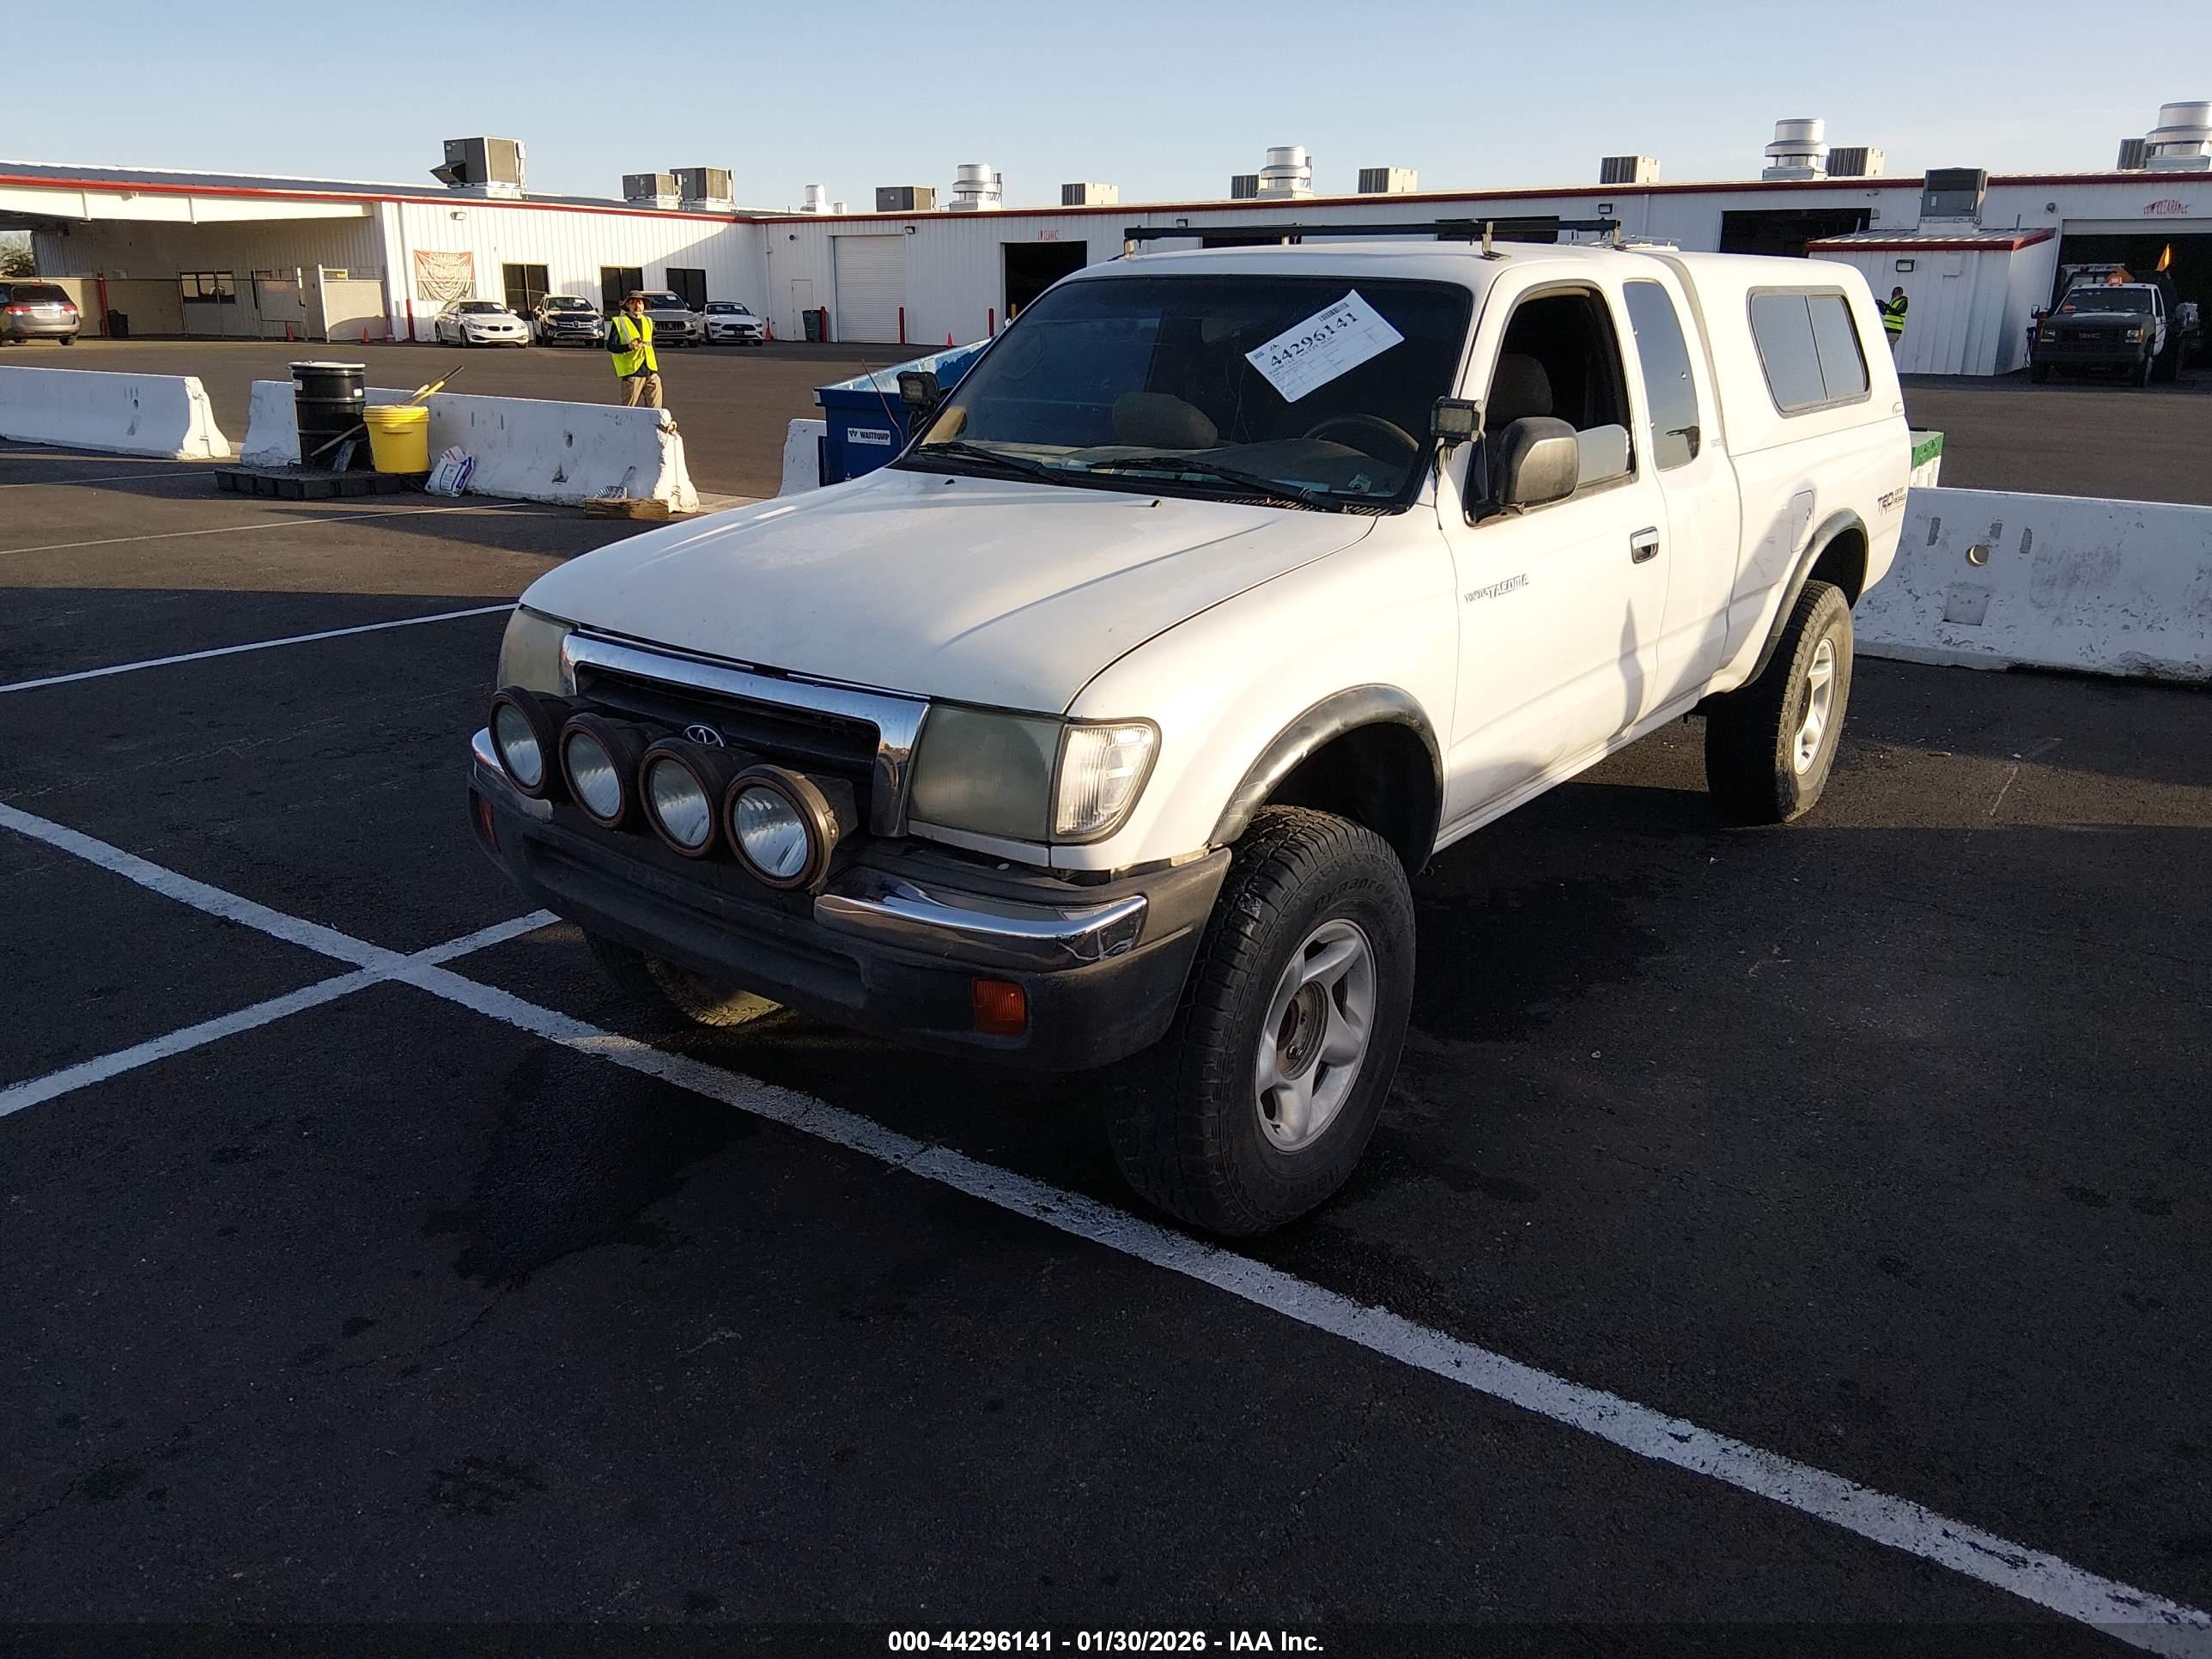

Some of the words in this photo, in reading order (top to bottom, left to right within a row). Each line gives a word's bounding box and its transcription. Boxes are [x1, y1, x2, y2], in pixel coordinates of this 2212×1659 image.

[1270, 313, 1358, 367] 44296141
[860, 431, 890, 441] WASTEQUIP
[1877, 491, 1894, 515] TRD
[1486, 573, 1529, 599] TACOMA
